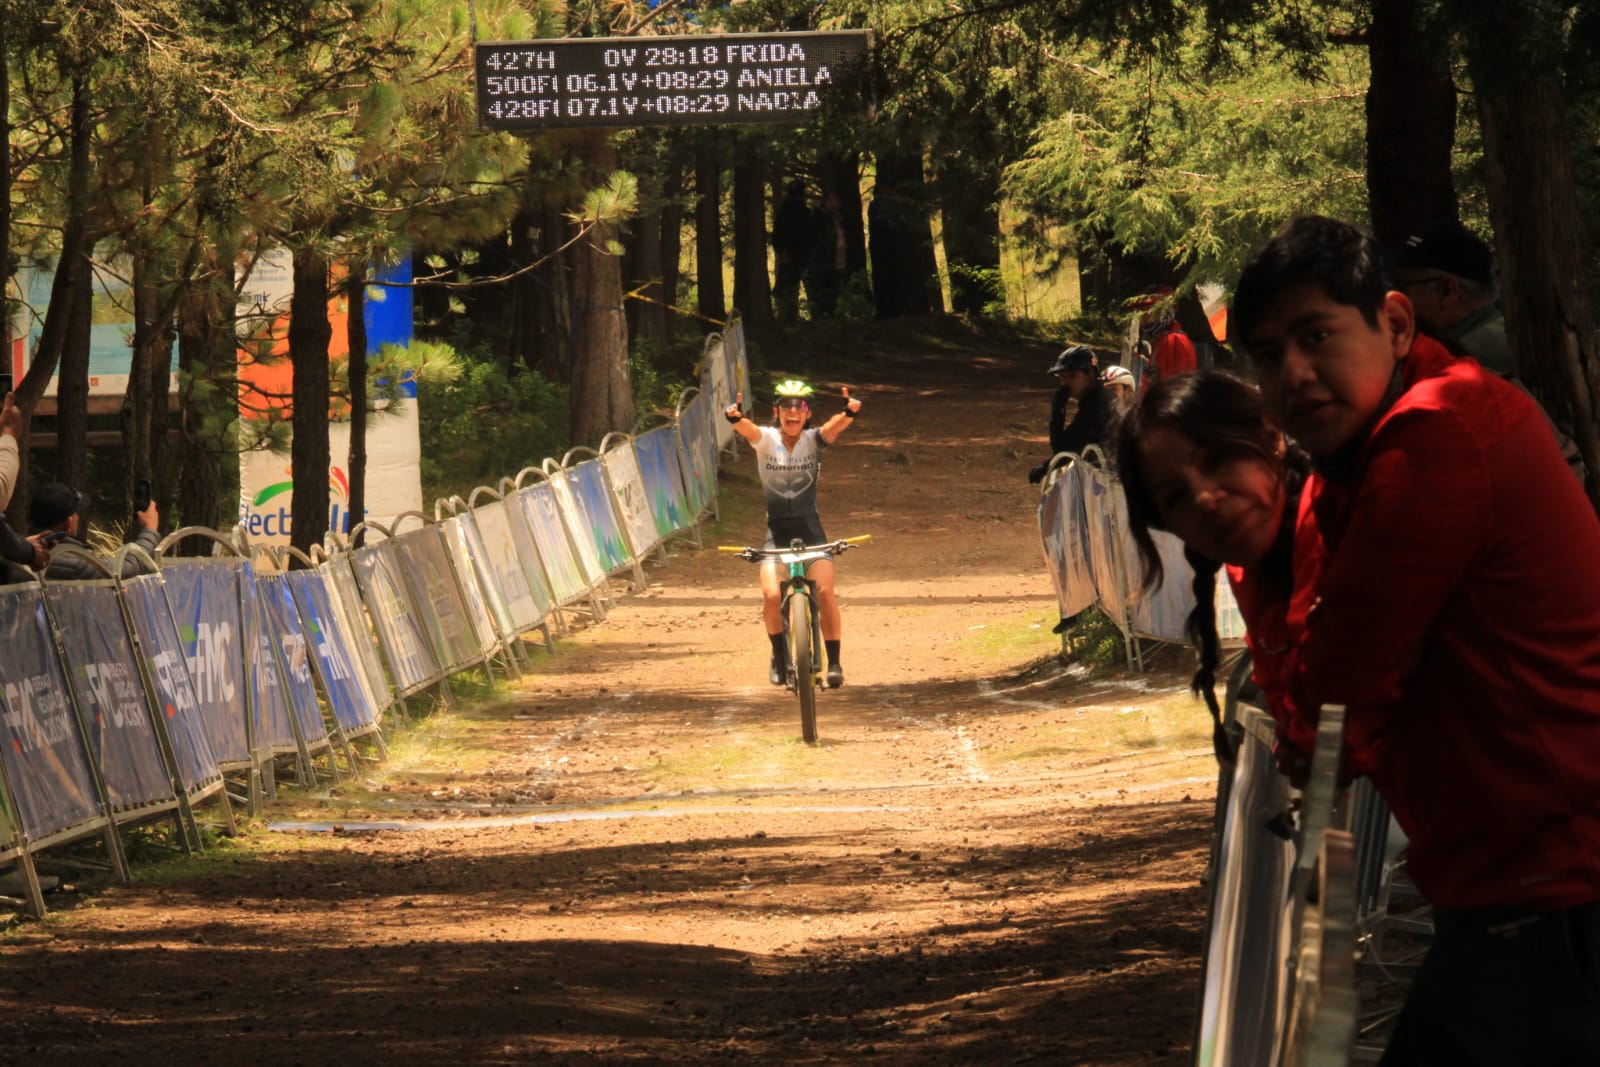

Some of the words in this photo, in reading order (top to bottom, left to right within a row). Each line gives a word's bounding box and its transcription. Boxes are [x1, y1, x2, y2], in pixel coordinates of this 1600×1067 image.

[487, 51, 555, 70] 427H
[645, 46, 719, 66] 28:18
[726, 43, 806, 63] FRIDA
[737, 66, 833, 88] ANIELA
